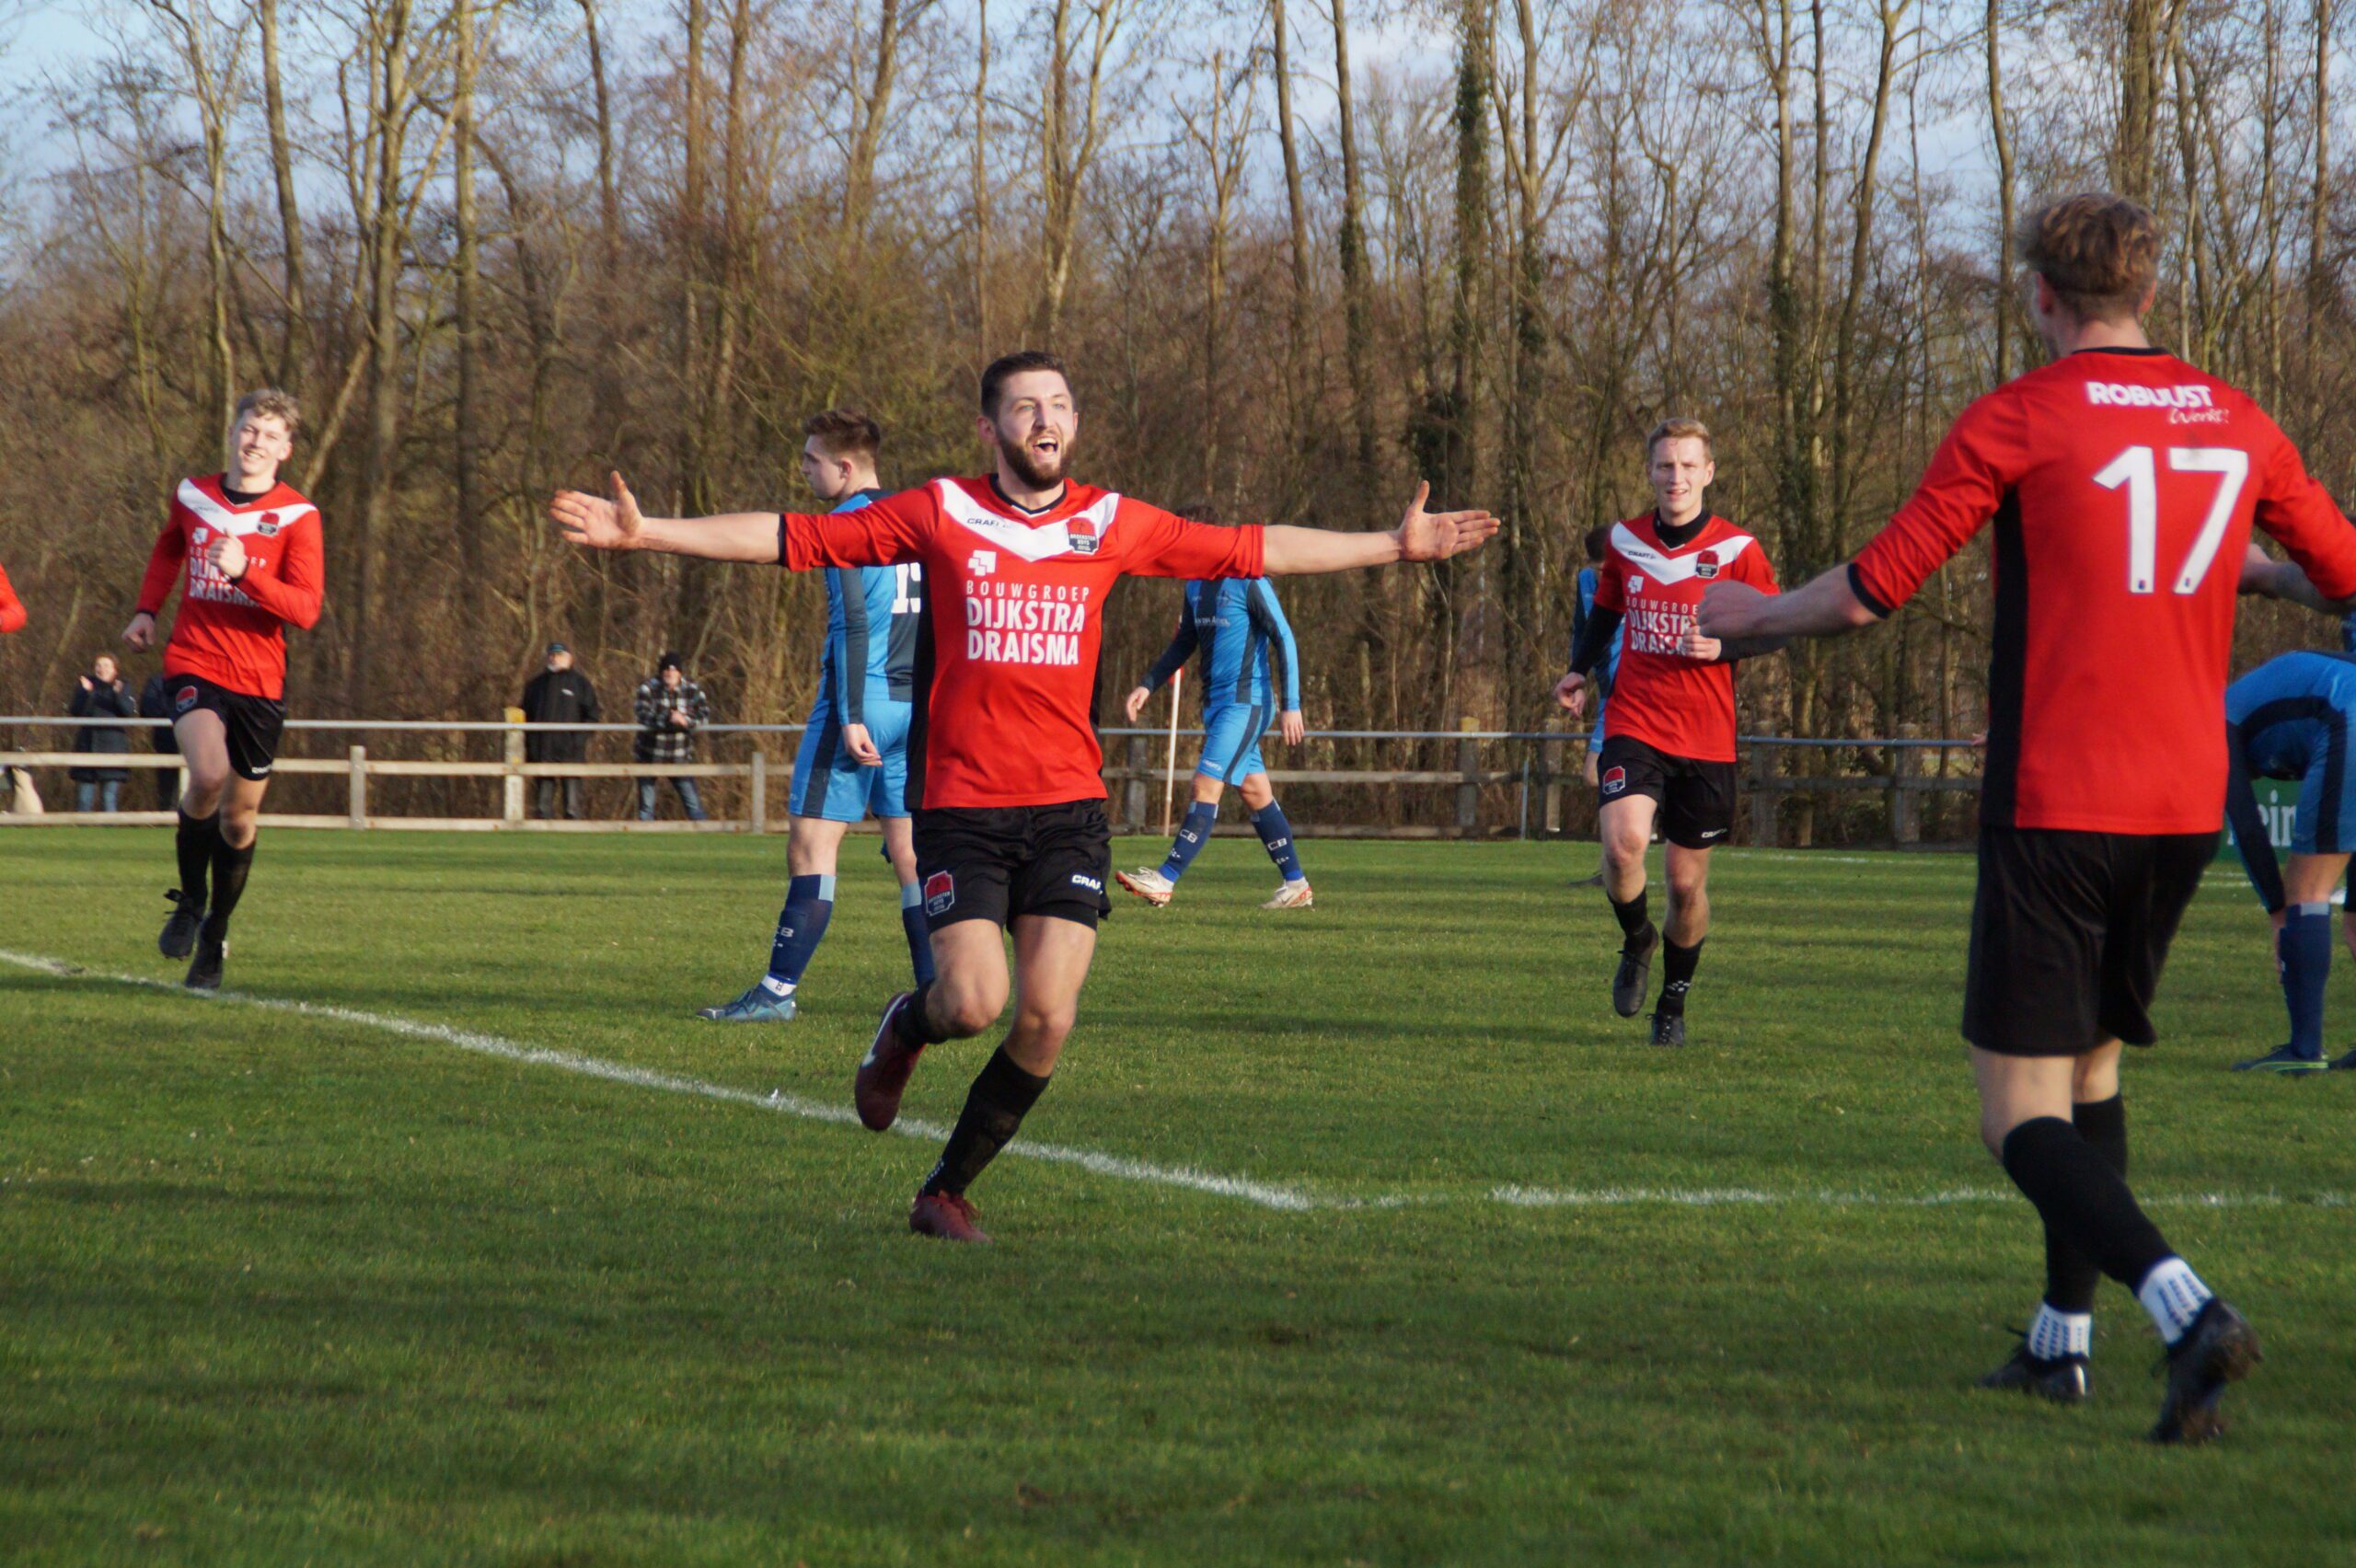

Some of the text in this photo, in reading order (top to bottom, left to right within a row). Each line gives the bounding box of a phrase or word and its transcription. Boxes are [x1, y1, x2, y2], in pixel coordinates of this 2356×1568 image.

[2091, 444, 2248, 594] 17
[966, 580, 1090, 601] BOUWGROEP
[1625, 595, 1699, 616] BOUWGROE
[965, 597, 1086, 633] DIJKSTRA
[1628, 607, 1692, 636] DIJKSTR
[967, 629, 1080, 665] DRAISMA
